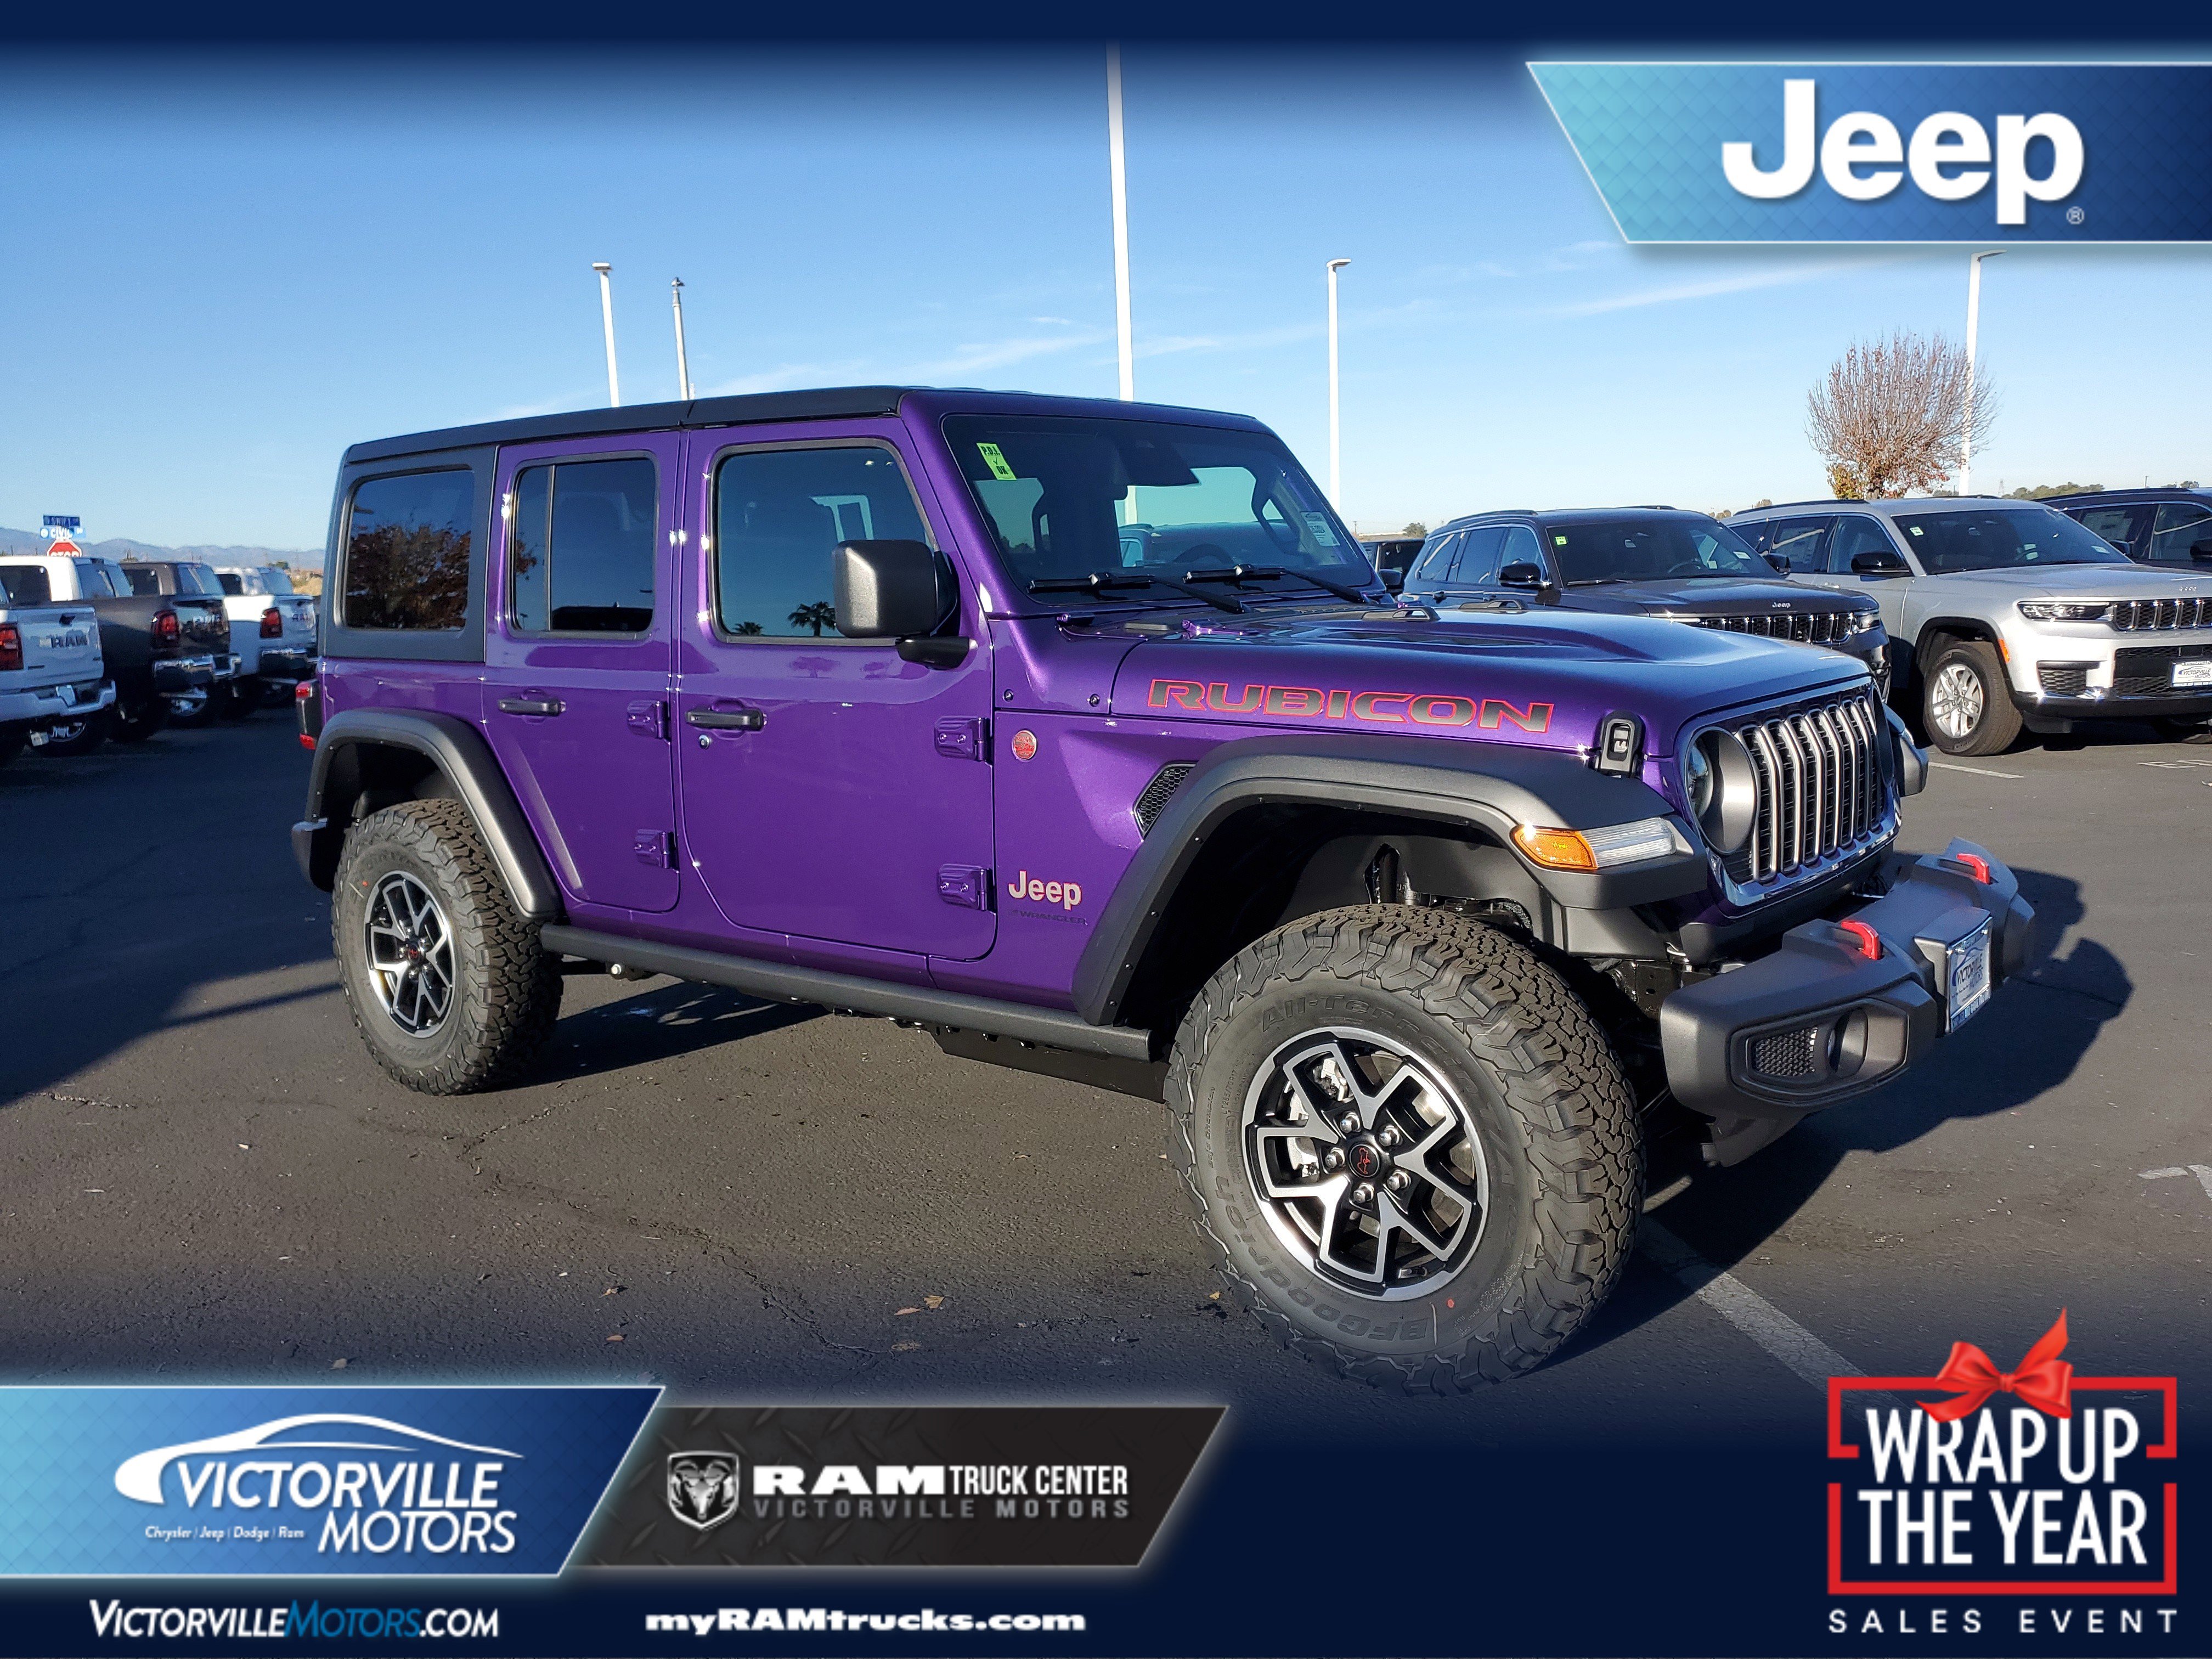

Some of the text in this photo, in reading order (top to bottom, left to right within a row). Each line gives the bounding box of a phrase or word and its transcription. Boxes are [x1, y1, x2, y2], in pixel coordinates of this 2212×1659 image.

[996, 466, 1009, 475] OK
[50, 634, 88, 648] RAM
[1147, 679, 1555, 733] RUBICON
[1008, 869, 1082, 911] Jeep
[1019, 911, 1088, 926] WRANGLER
[1215, 1175, 1427, 1341] BFGoodrich
